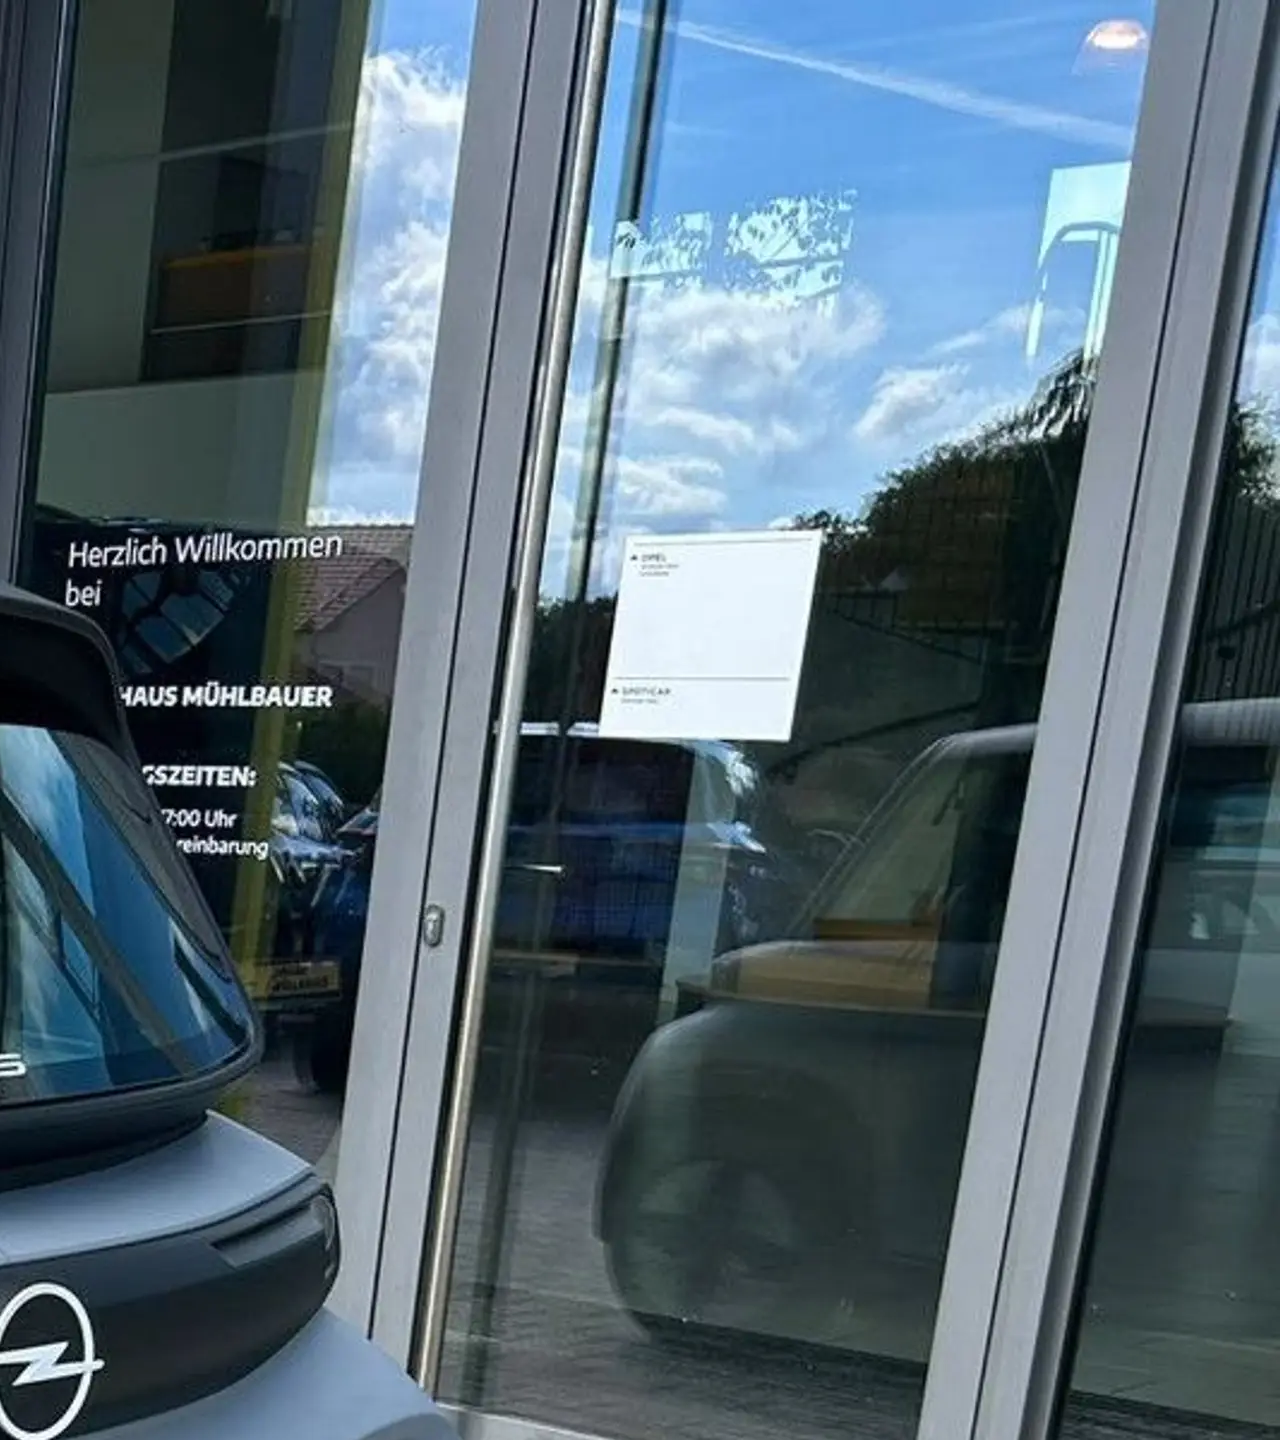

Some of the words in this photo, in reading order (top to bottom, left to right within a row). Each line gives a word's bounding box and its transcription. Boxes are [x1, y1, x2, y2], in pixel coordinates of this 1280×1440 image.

[68, 536, 166, 568] Herzlich
[174, 532, 342, 564] Willkommen
[65, 578, 102, 606] bei
[182, 681, 333, 707] MÜHLBAUER
[204, 807, 237, 828] Uhr
